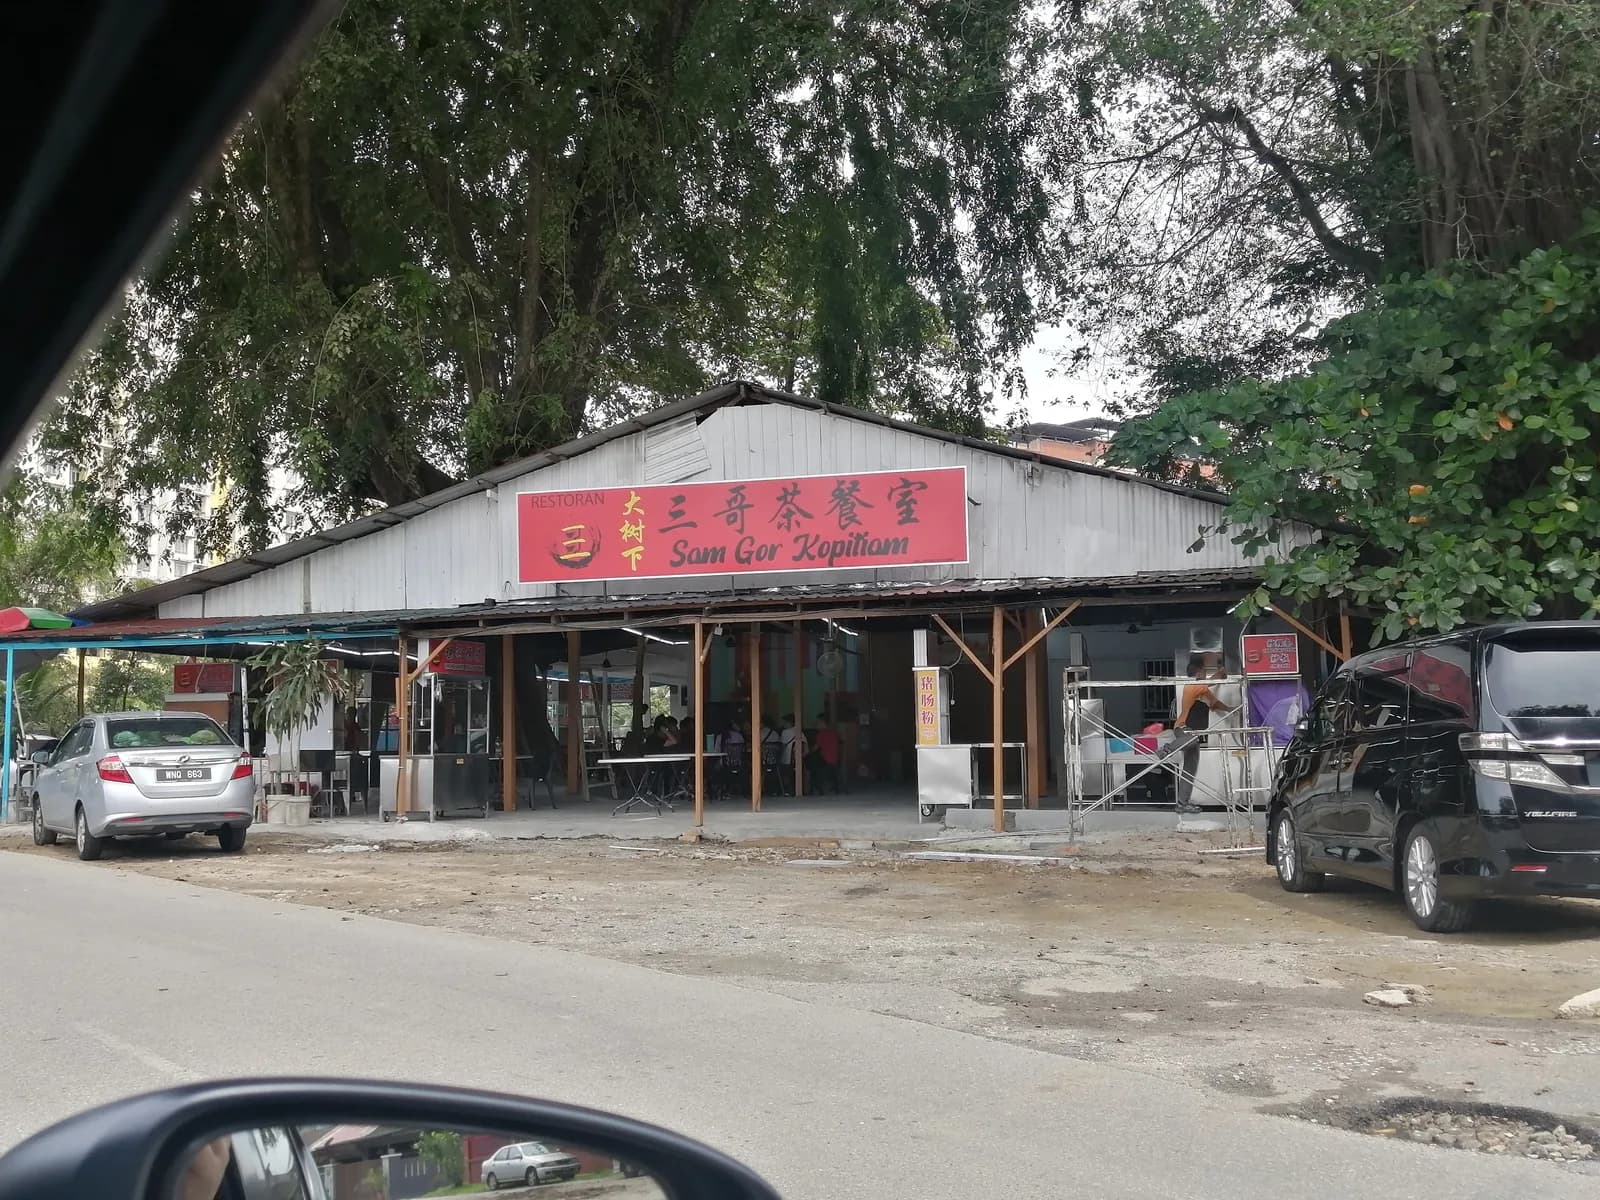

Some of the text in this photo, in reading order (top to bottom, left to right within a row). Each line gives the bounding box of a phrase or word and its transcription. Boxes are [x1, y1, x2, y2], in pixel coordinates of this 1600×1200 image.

[531, 492, 605, 508] RESTORAN
[658, 476, 928, 535] 三哥茶餐室
[619, 490, 645, 571] 大树下
[669, 531, 909, 567] Sam Gor Kopitiam
[920, 676, 934, 724] 猪肠粉
[187, 770, 203, 778] 663
